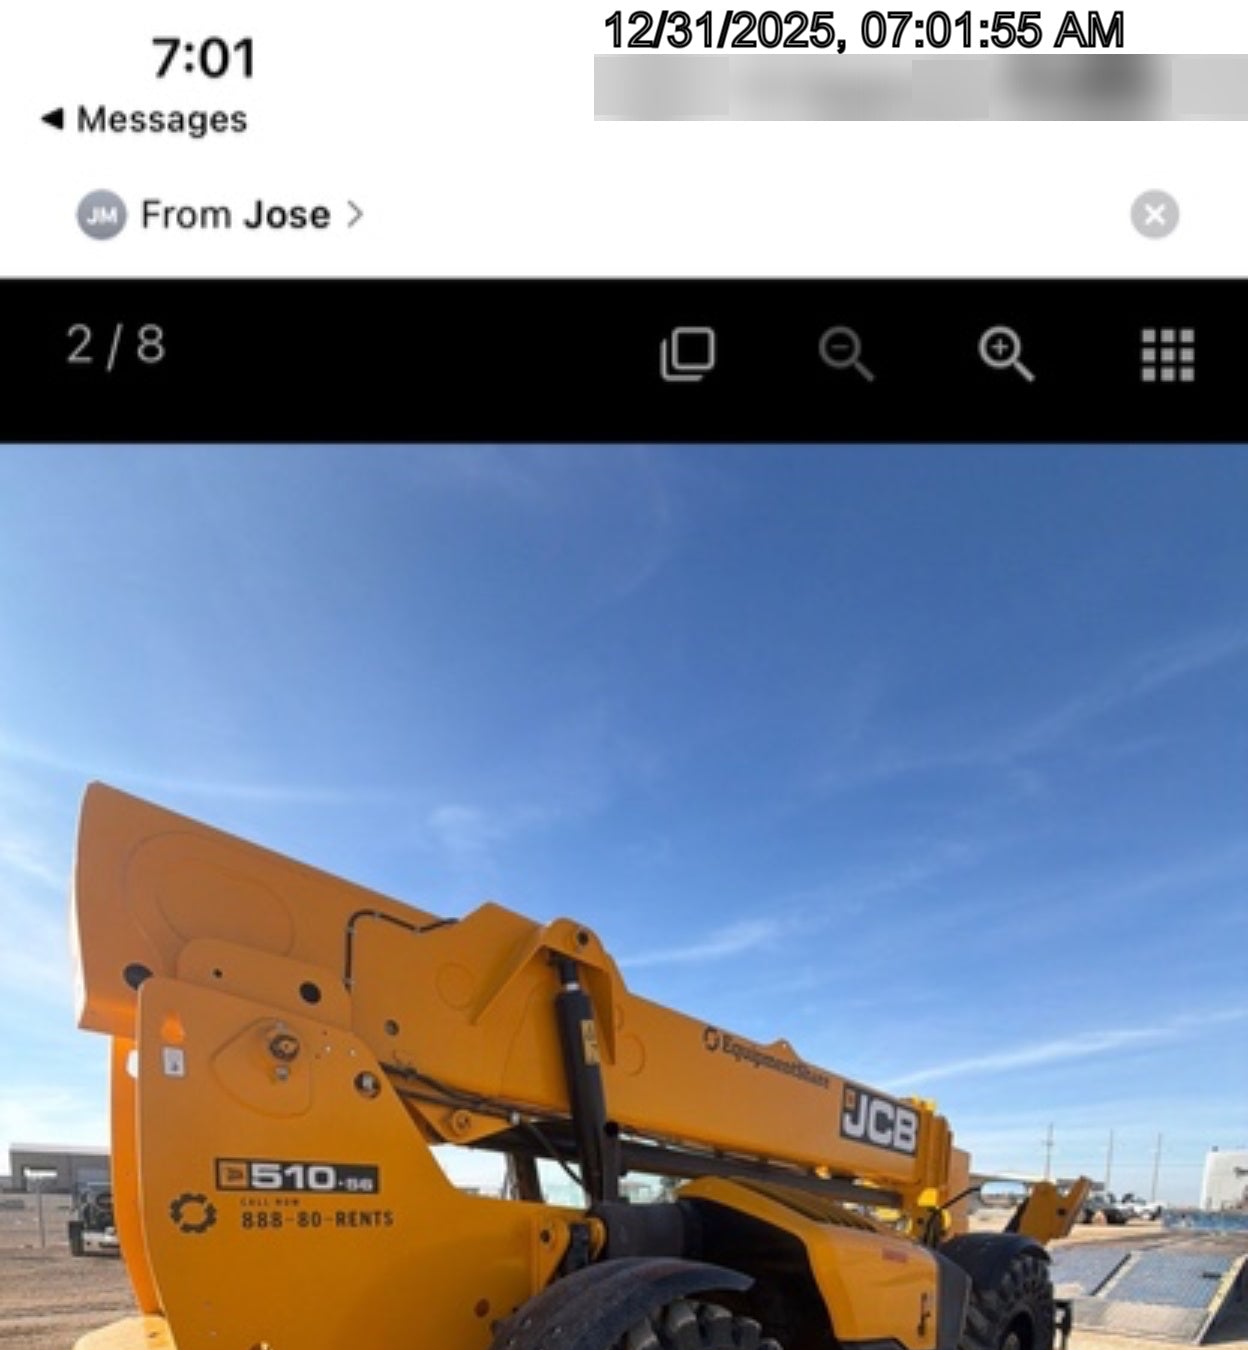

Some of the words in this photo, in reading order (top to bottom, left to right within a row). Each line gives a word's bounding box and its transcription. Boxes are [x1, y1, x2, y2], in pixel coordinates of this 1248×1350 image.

[151, 35, 255, 80] 7:01
[77, 104, 248, 140] Messages
[86, 206, 118, 225] JM
[142, 198, 232, 230] From
[243, 199, 332, 230] Jose
[67, 323, 93, 363] 2
[137, 323, 166, 364] 8
[842, 1092, 920, 1152] JCB
[241, 1210, 395, 1230] 888-80-RENTS
